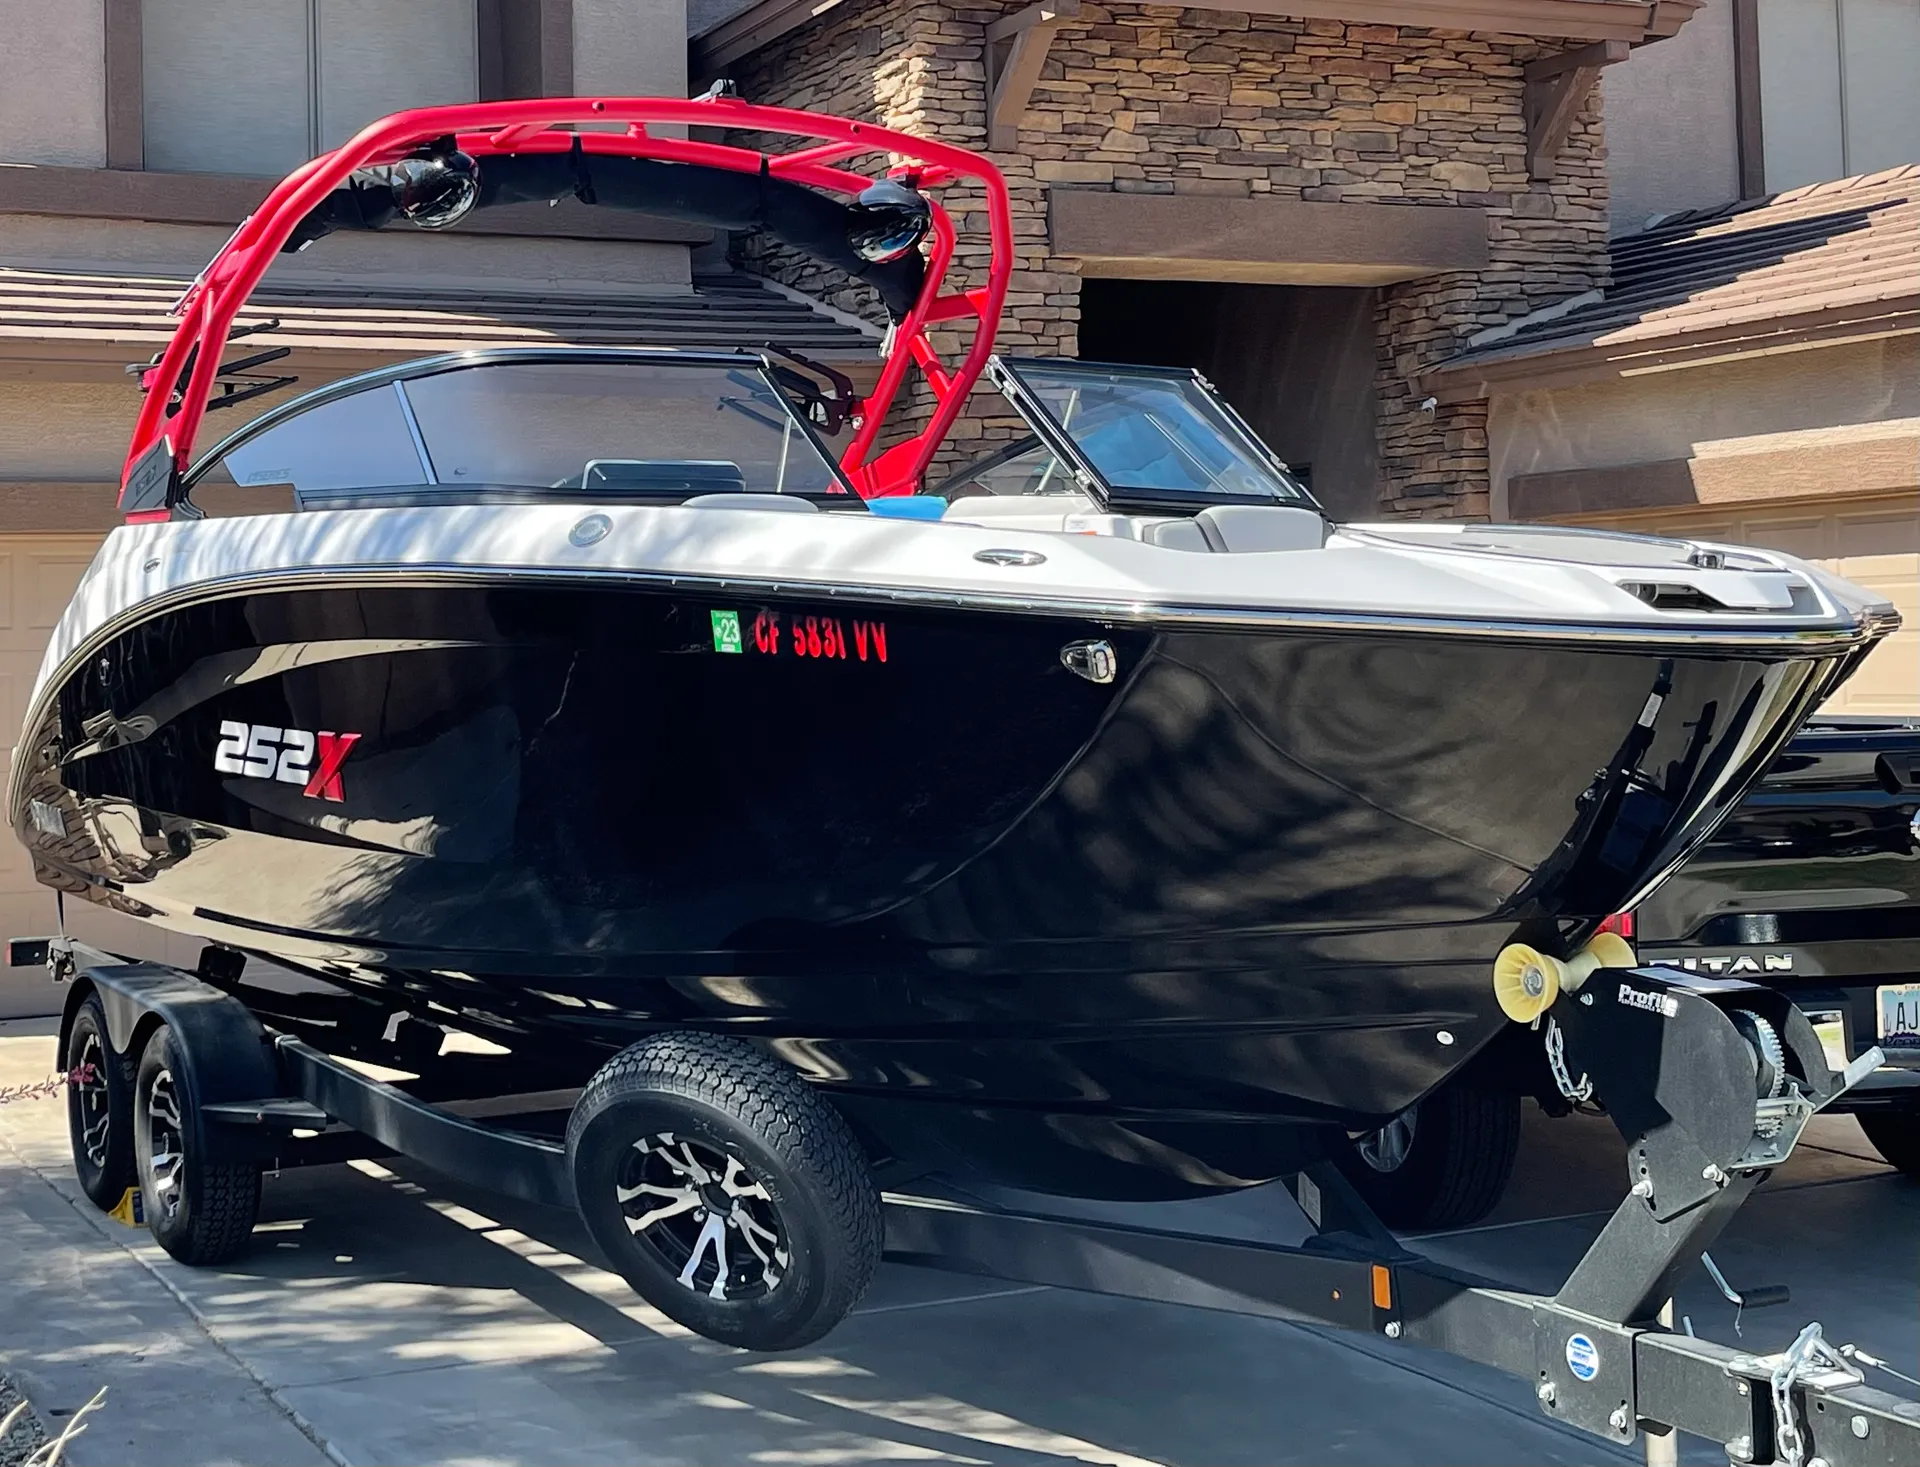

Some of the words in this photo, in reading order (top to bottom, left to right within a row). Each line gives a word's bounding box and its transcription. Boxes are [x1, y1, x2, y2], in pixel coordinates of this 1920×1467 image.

[721, 618, 740, 643] 23
[755, 611, 779, 654] CF
[792, 615, 847, 660] 5831
[215, 720, 362, 803] 252X
[1618, 984, 1678, 1014] Profile
[1896, 1001, 1919, 1031] AJ
